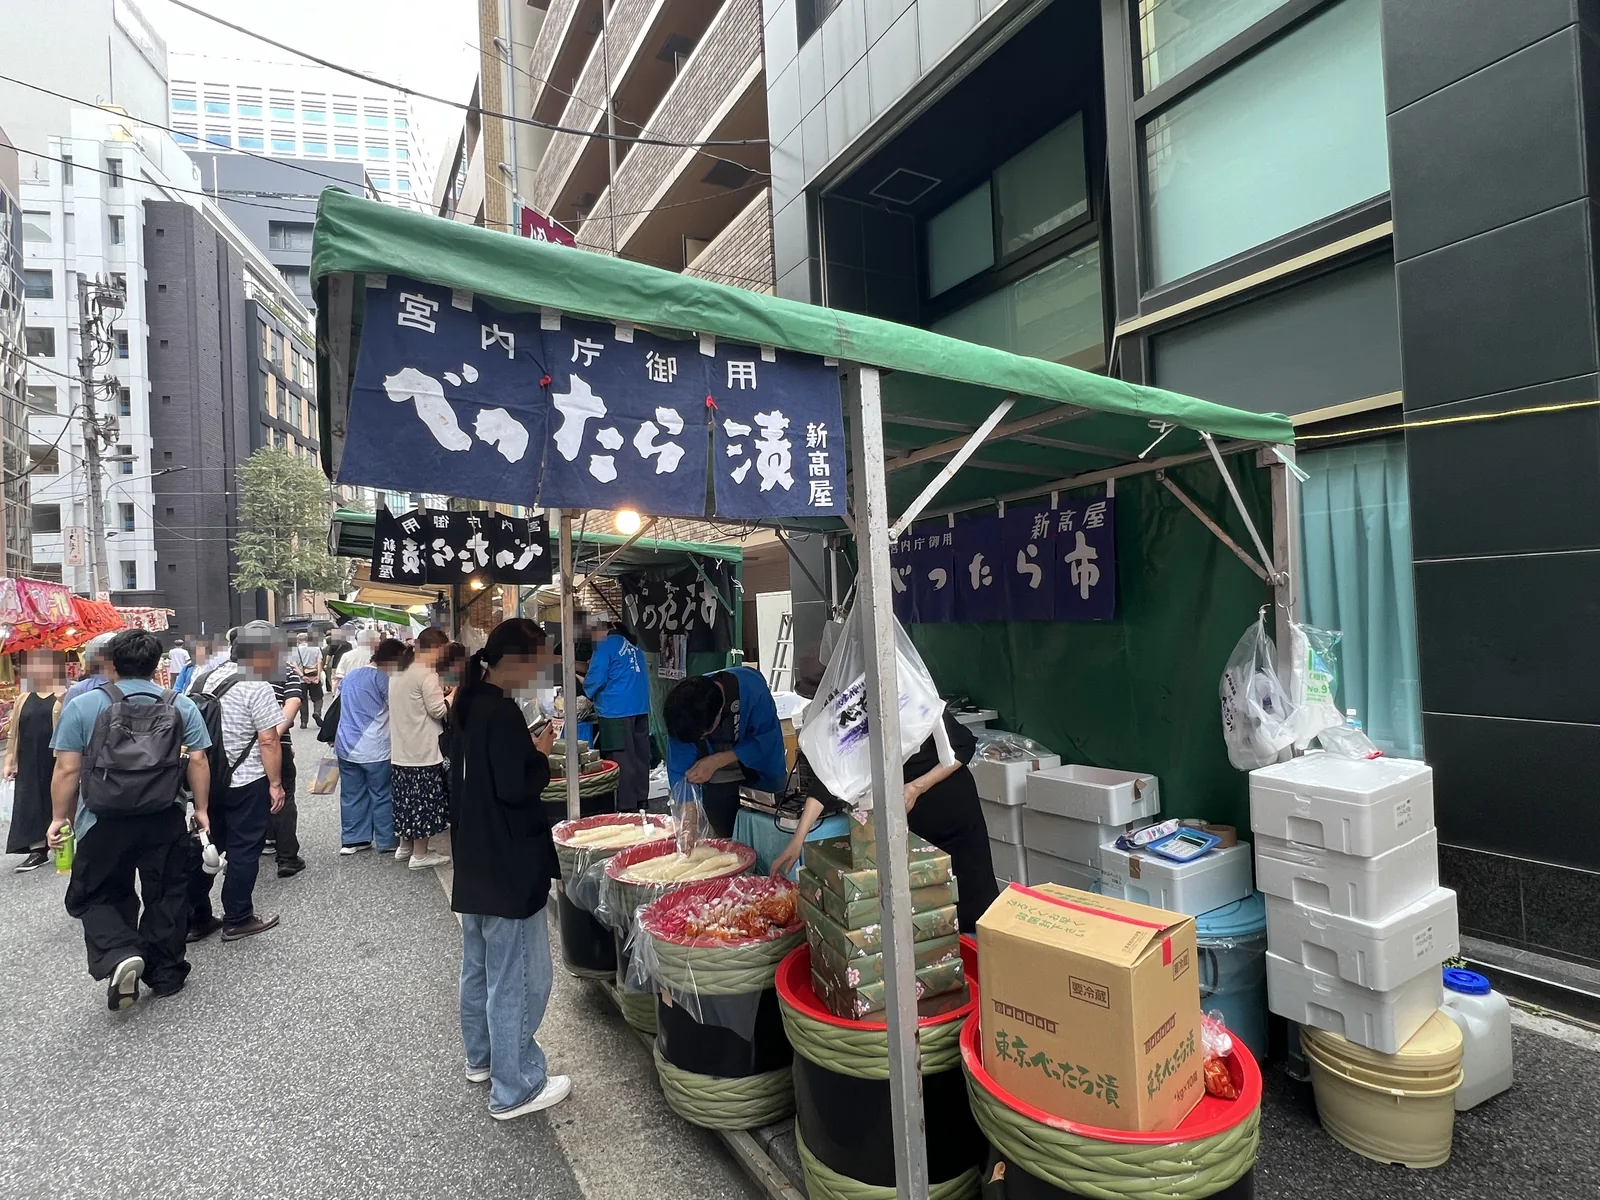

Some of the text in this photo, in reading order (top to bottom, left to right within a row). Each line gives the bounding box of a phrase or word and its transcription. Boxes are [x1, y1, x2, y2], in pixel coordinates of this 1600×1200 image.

[397, 292, 758, 391] 宮内庁御用
[383, 362, 796, 492] べったら漬
[1071, 980, 1108, 1004] 要冷蔵
[994, 1028, 1120, 1109] 東京べったら漬
